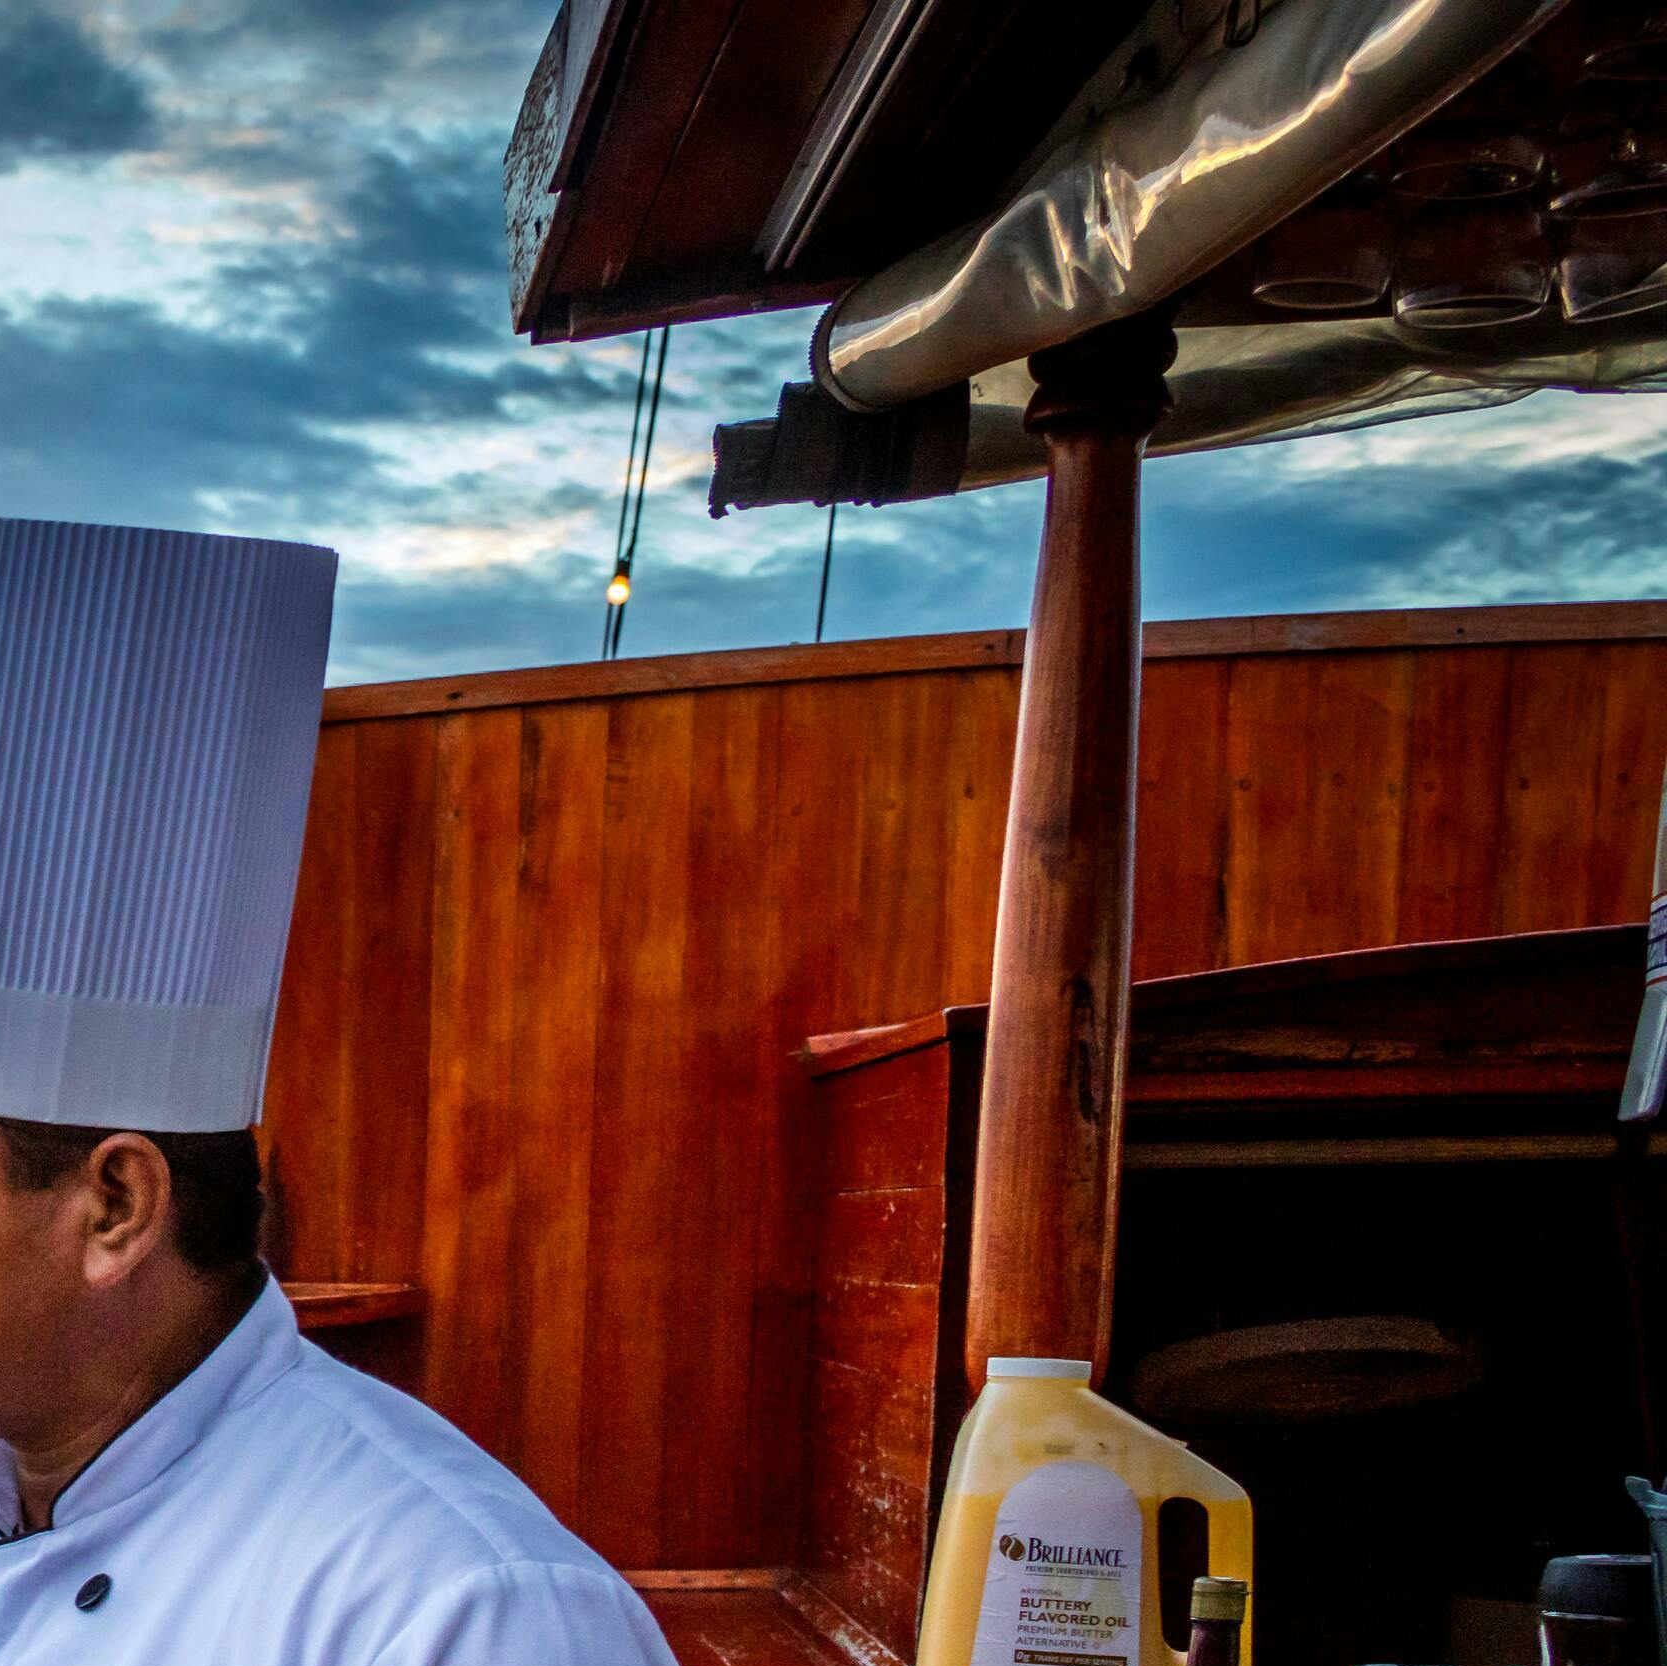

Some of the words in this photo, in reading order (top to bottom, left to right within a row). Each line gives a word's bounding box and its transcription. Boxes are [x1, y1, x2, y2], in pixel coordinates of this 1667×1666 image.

[1020, 1588, 1063, 1597] ARTIFICIAL
[1020, 1597, 1092, 1611] BUTTERY
[1018, 1611, 1100, 1626] FLAVORED
[1104, 1616, 1131, 1628] OIL
[1016, 1624, 1067, 1636] PREMIUM
[1070, 1628, 1114, 1639] BUTTER
[1015, 1636, 1088, 1649] ALTERNATIVE
